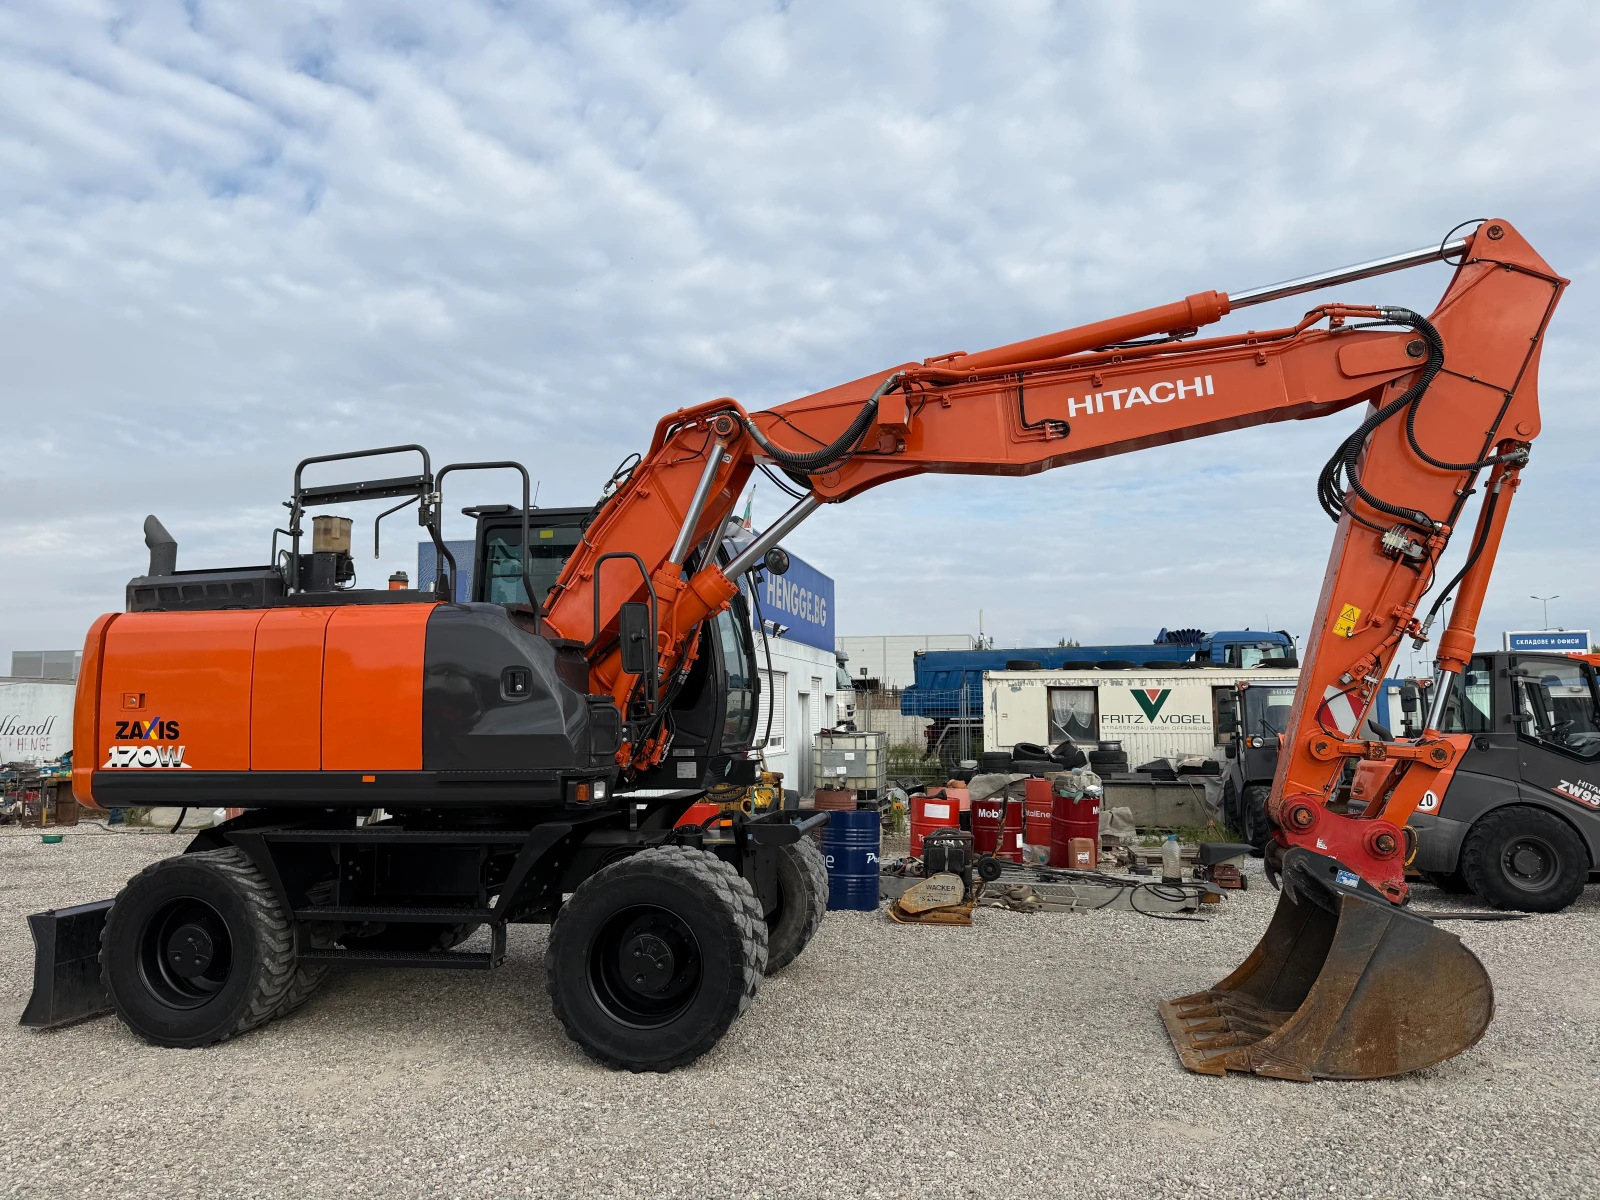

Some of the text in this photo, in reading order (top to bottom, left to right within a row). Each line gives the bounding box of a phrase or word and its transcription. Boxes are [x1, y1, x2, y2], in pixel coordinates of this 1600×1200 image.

[1067, 375, 1215, 418] HITACHI
[766, 571, 827, 628] HENGGE.BG
[1516, 638, 1549, 646] СКЛАДОВЕ
[115, 716, 180, 740] ZAXIS
[1101, 714, 1211, 724] FRITZ VOGEL
[108, 745, 186, 768] 170W
[1577, 779, 1600, 794] HITA
[926, 883, 956, 893] WACKER
